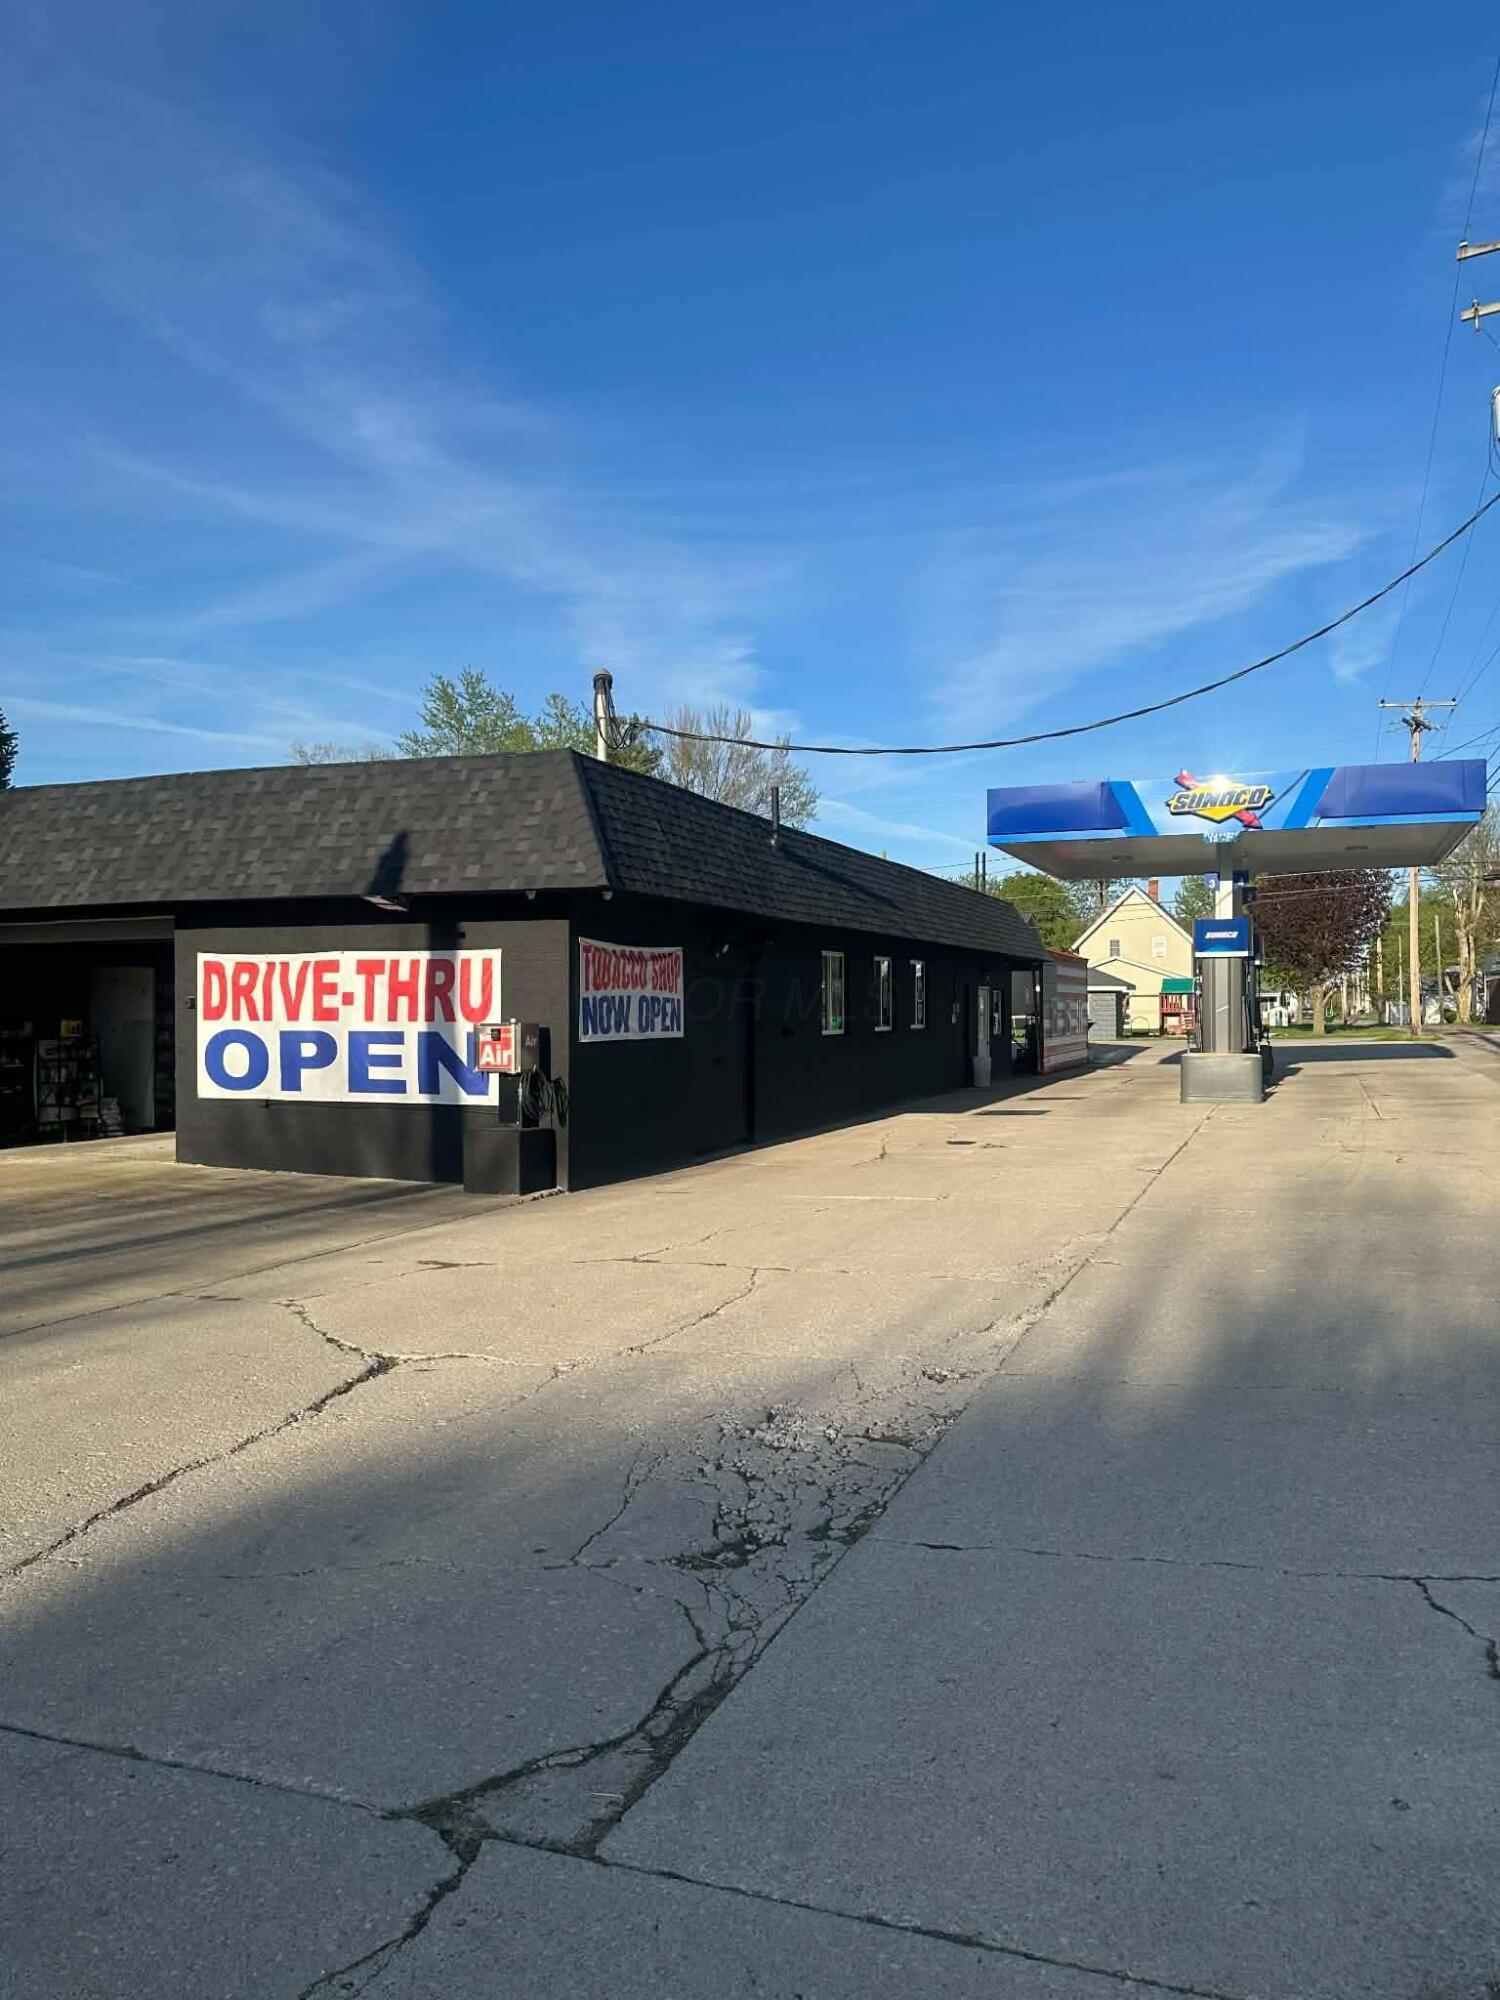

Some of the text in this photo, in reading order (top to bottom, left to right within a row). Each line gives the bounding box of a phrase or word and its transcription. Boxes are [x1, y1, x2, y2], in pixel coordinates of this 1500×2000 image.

[1174, 787, 1267, 811] SUNOCO
[1208, 879, 1217, 889] 3
[582, 945, 681, 993] TOBACCO SHOP
[203, 958, 493, 1022] DRIVE-THRU
[581, 994, 682, 1036] NOW OPEN
[481, 1043, 512, 1066] Air
[525, 1034, 538, 1048] Air
[204, 1028, 490, 1096] OPEN
